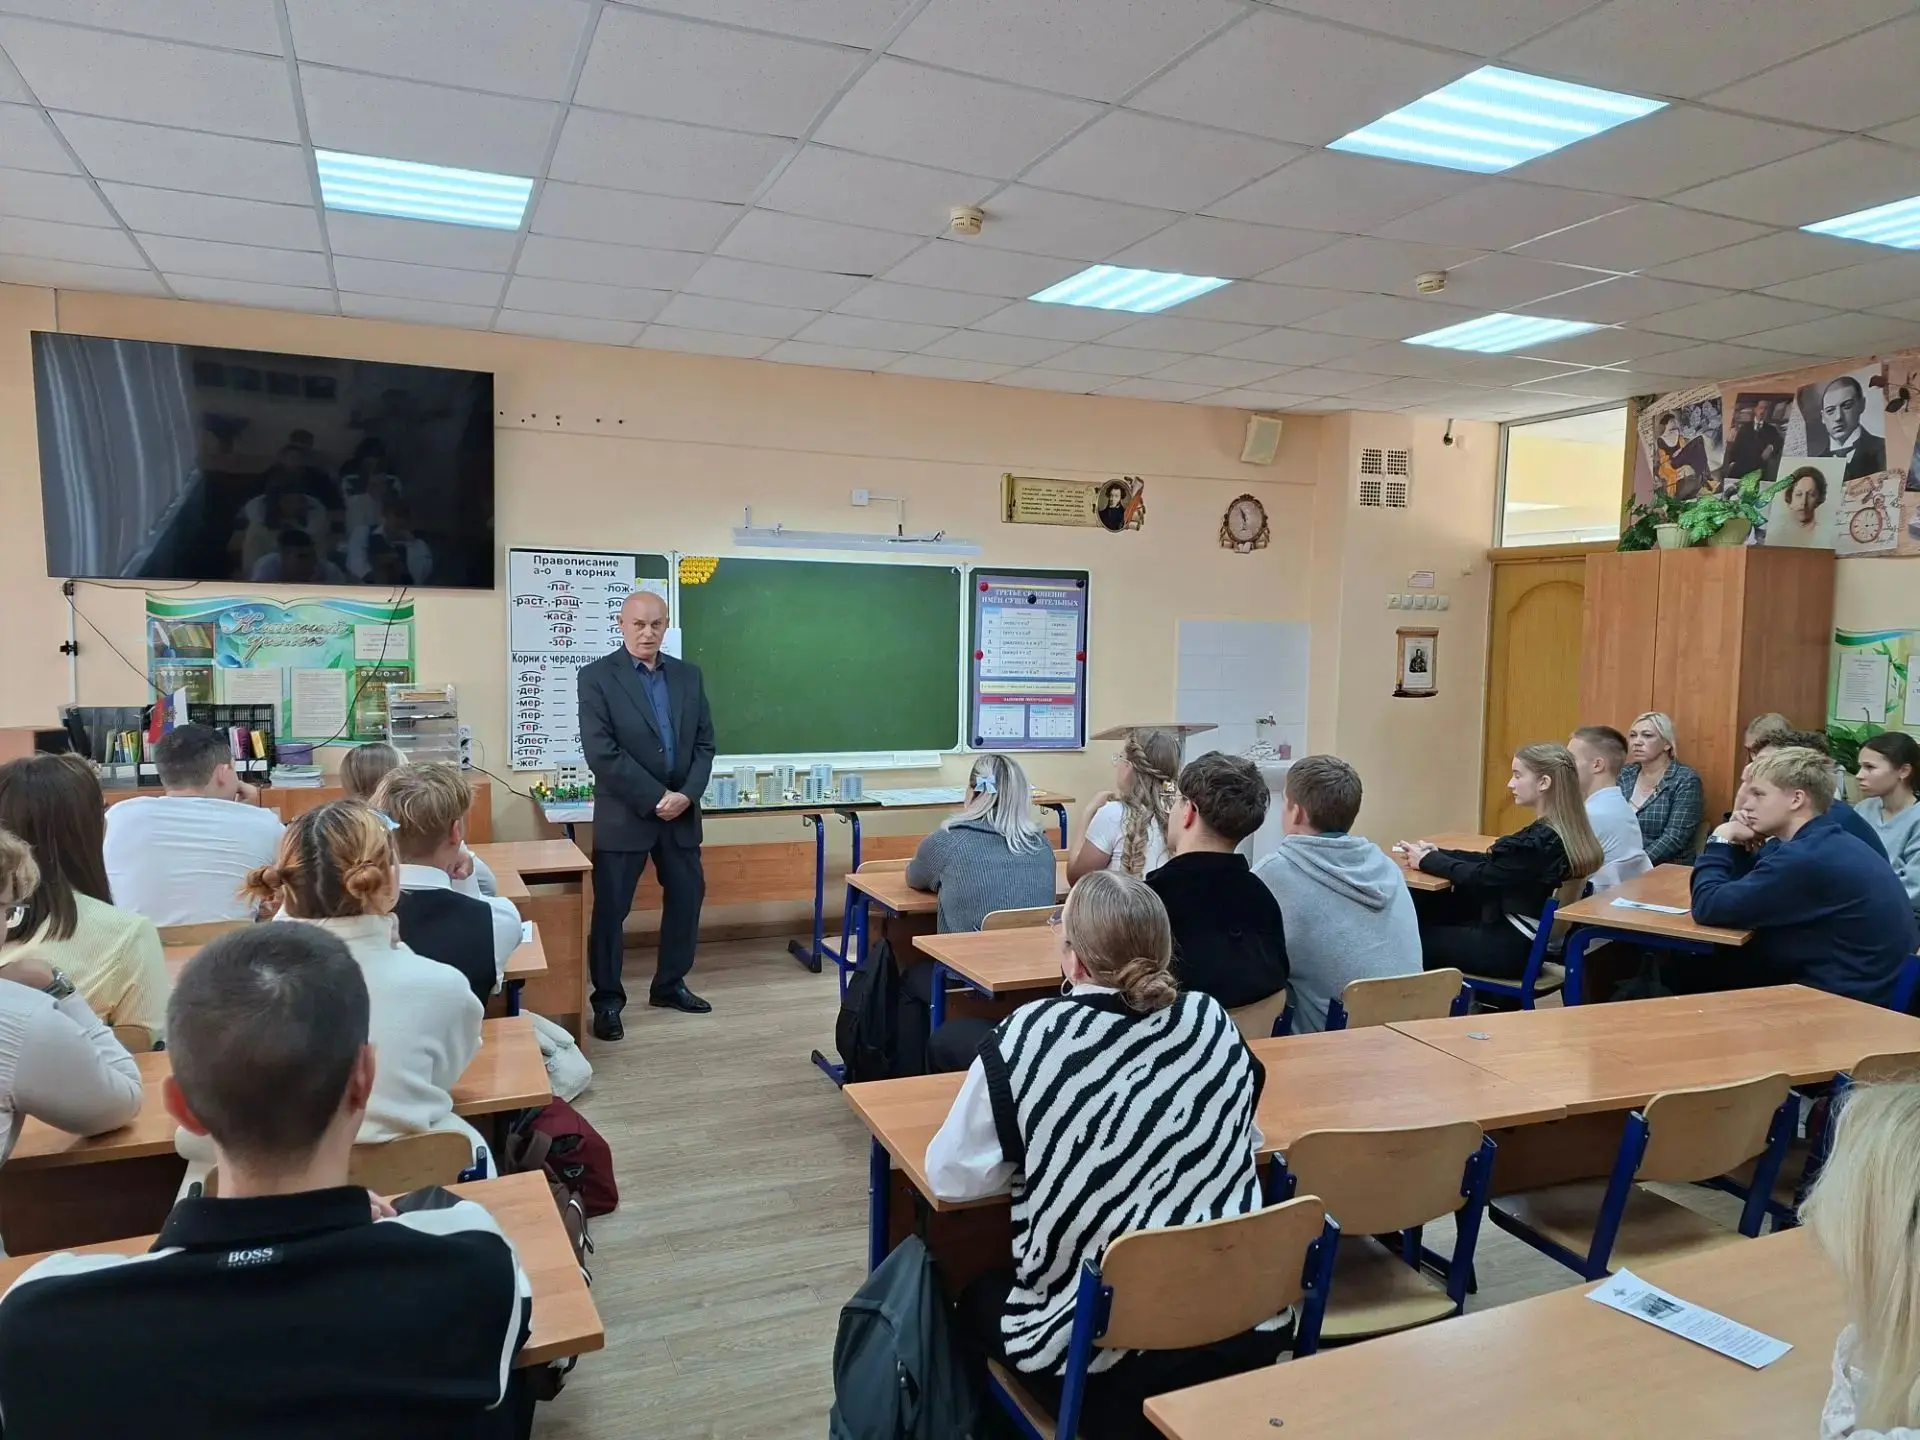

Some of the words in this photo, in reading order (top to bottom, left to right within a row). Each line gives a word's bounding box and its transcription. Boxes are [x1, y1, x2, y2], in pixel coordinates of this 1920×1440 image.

[534, 555, 619, 567] Правописание
[534, 567, 551, 575] а-о
[576, 568, 616, 578] корнях
[1004, 597, 1079, 607] СУЩЕСВИТЕЛЬНЫХ
[512, 653, 540, 664] Корни
[228, 1247, 273, 1263] BOSS
